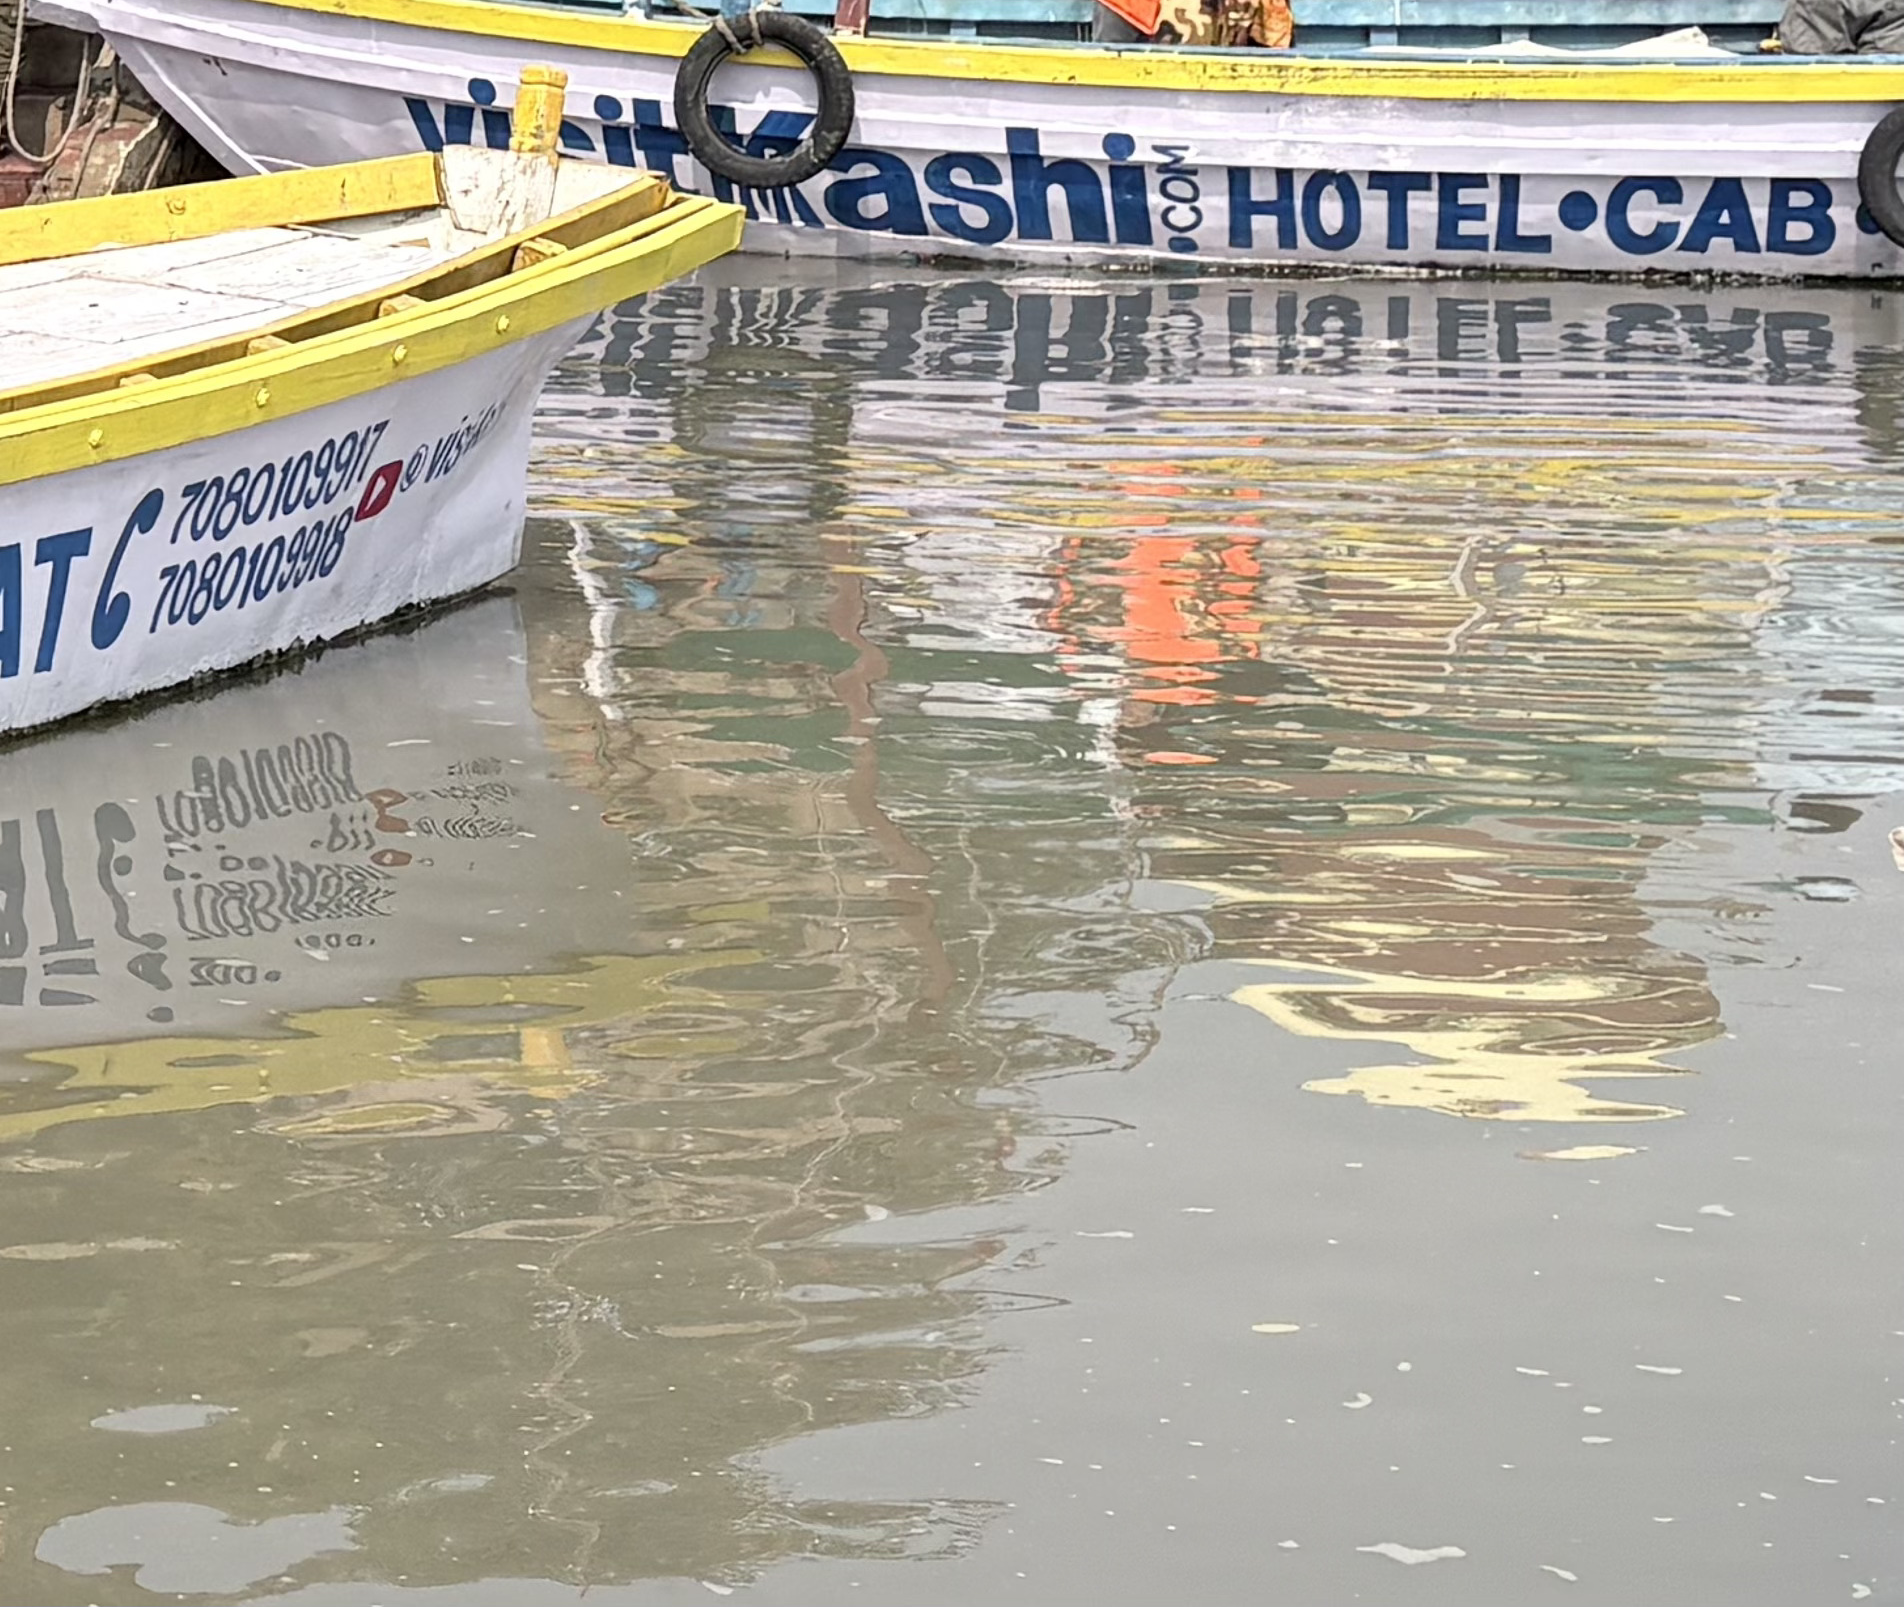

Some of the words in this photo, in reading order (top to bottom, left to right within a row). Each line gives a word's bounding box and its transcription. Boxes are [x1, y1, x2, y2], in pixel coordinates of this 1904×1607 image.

[1227, 167, 1552, 252] HOTEL
[1605, 176, 1837, 256] CAB
[170, 420, 390, 544] 7080109917
[149, 506, 354, 634] 7080109918
